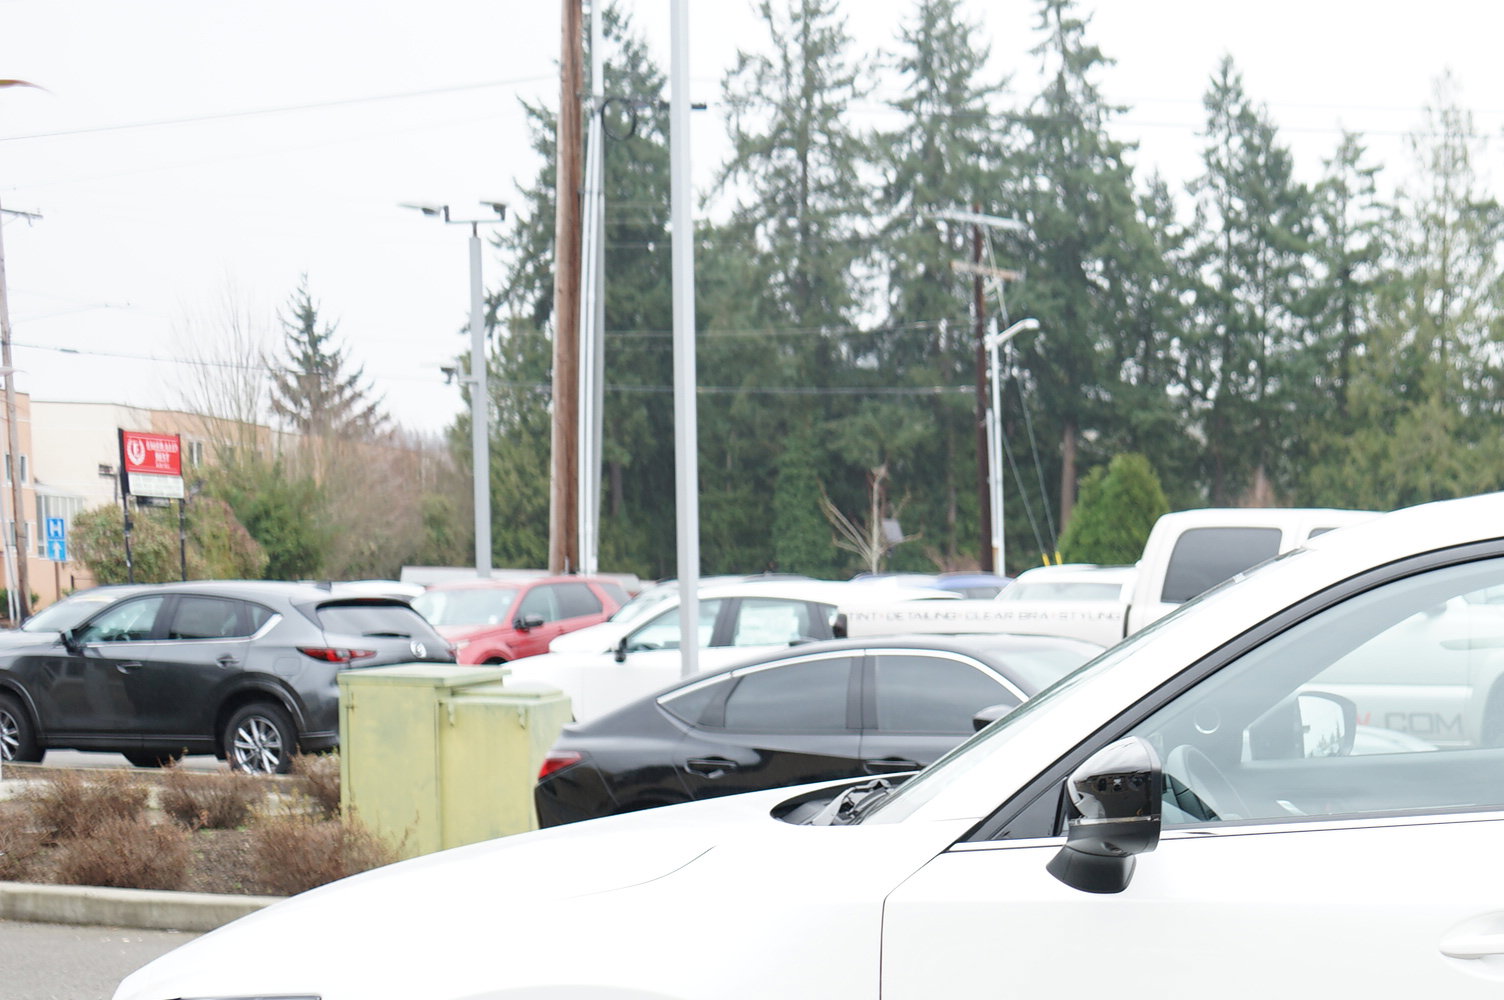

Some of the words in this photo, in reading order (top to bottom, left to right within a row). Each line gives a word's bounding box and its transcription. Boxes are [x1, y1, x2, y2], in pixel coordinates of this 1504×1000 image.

[50, 520, 63, 537] H
[849, 611, 877, 621] TINT
[886, 611, 957, 621] DETAILING
[965, 611, 1013, 621] CLEAR
[1018, 611, 1049, 621] BRA
[1058, 611, 1121, 621] STYLING
